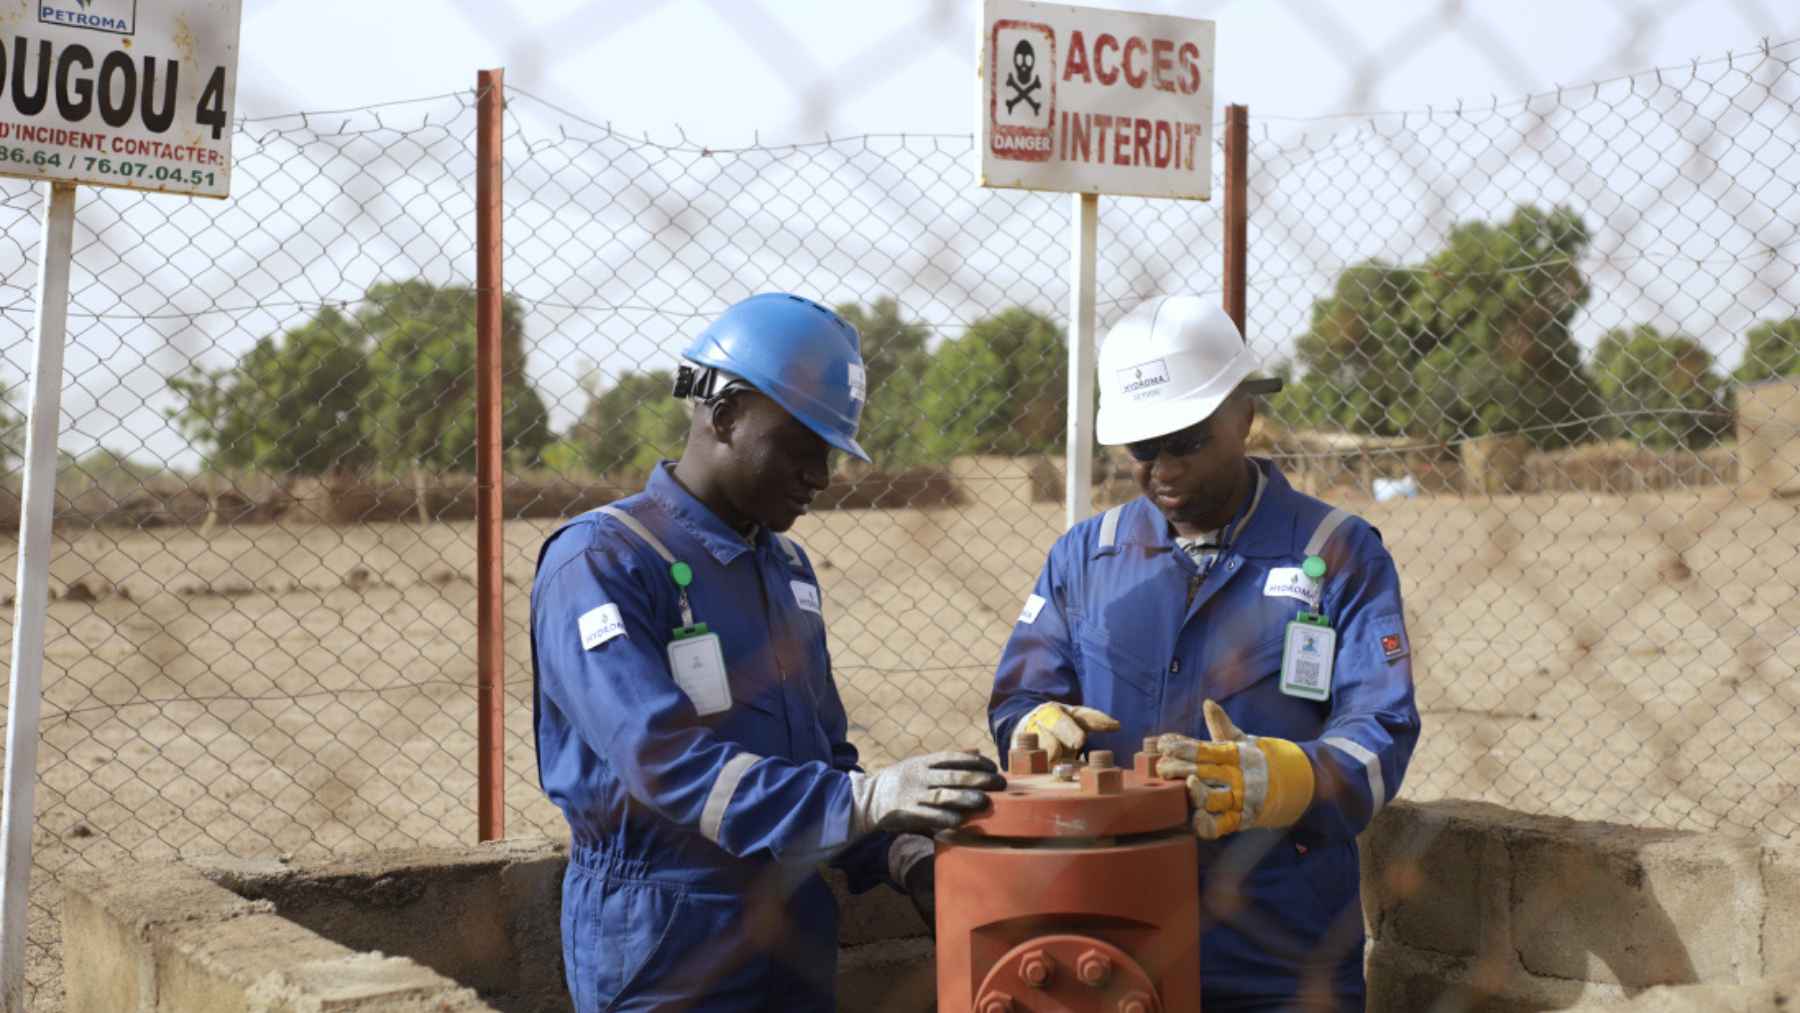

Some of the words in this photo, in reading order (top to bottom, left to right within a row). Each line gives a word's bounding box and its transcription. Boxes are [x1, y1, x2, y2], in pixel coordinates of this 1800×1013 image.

[42, 6, 127, 31] PETROMA
[1062, 30, 1201, 95] ACCES
[0, 36, 179, 134] UGOU
[196, 66, 226, 140] 4
[0, 122, 107, 151] D'INCIDENT
[111, 136, 224, 166] CONTACTER:
[994, 135, 1050, 151] DANGER
[1060, 111, 1202, 171] INTERDIT
[68, 155, 76, 170] /
[84, 156, 216, 187] 76.07.04.51
